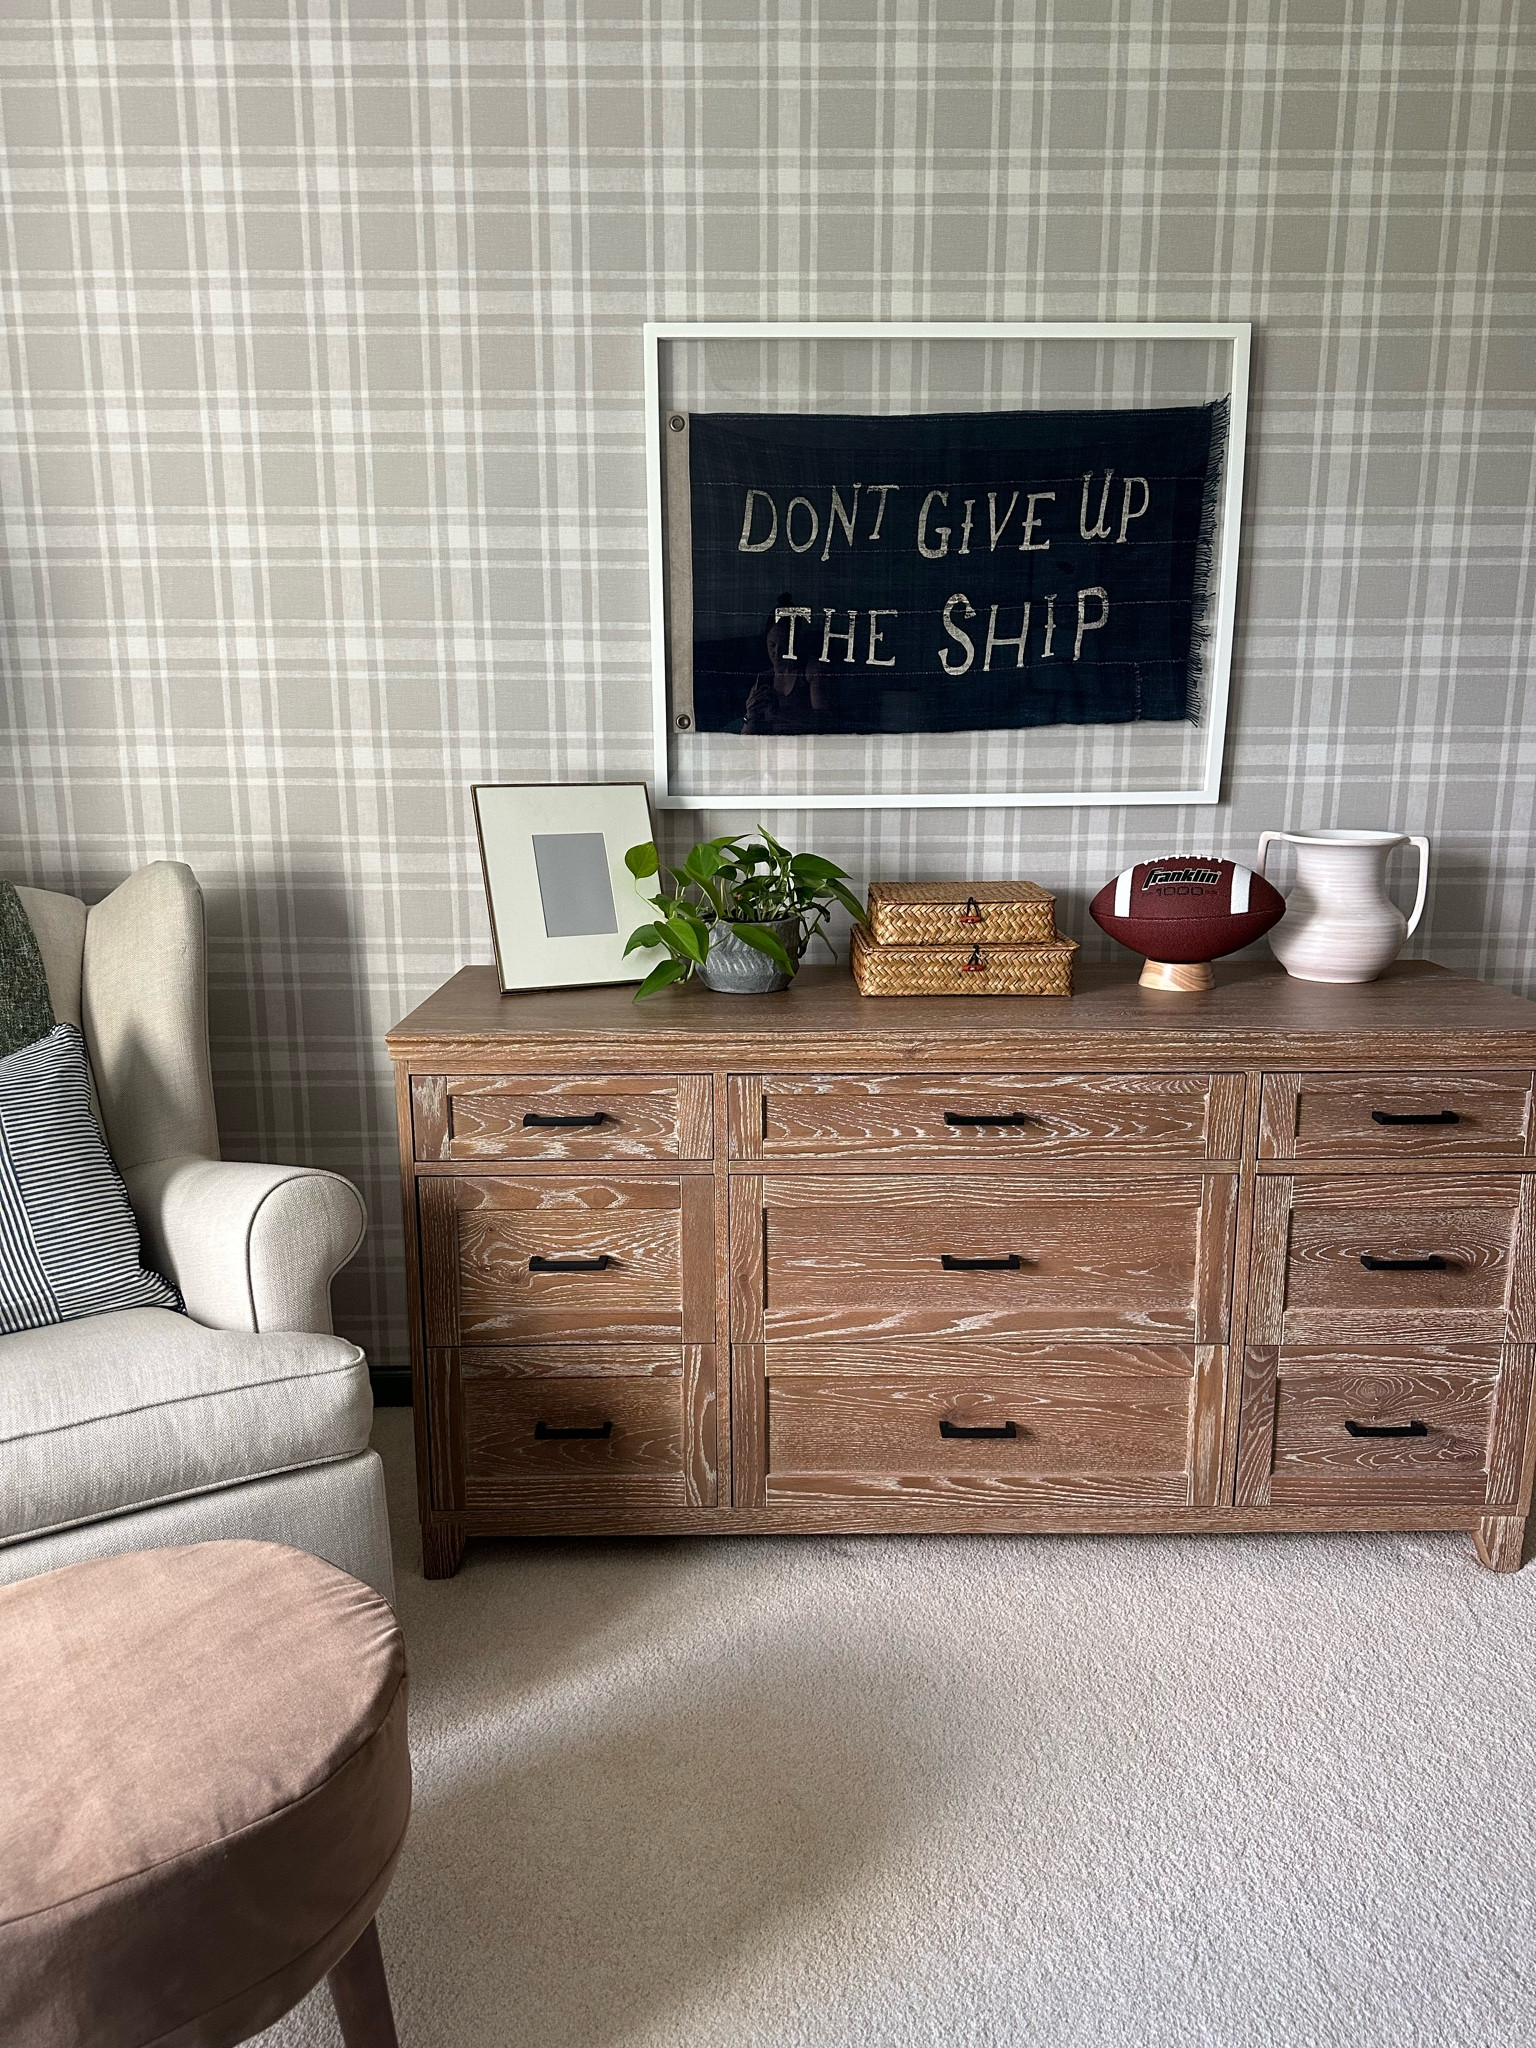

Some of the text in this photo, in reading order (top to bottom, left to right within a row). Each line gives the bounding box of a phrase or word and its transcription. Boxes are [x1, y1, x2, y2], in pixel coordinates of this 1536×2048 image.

[917, 489, 1056, 559] GIVE
[1079, 468, 1150, 543] UP
[774, 586, 1110, 676] THE SHIP
[1156, 886, 1203, 897] 1000
